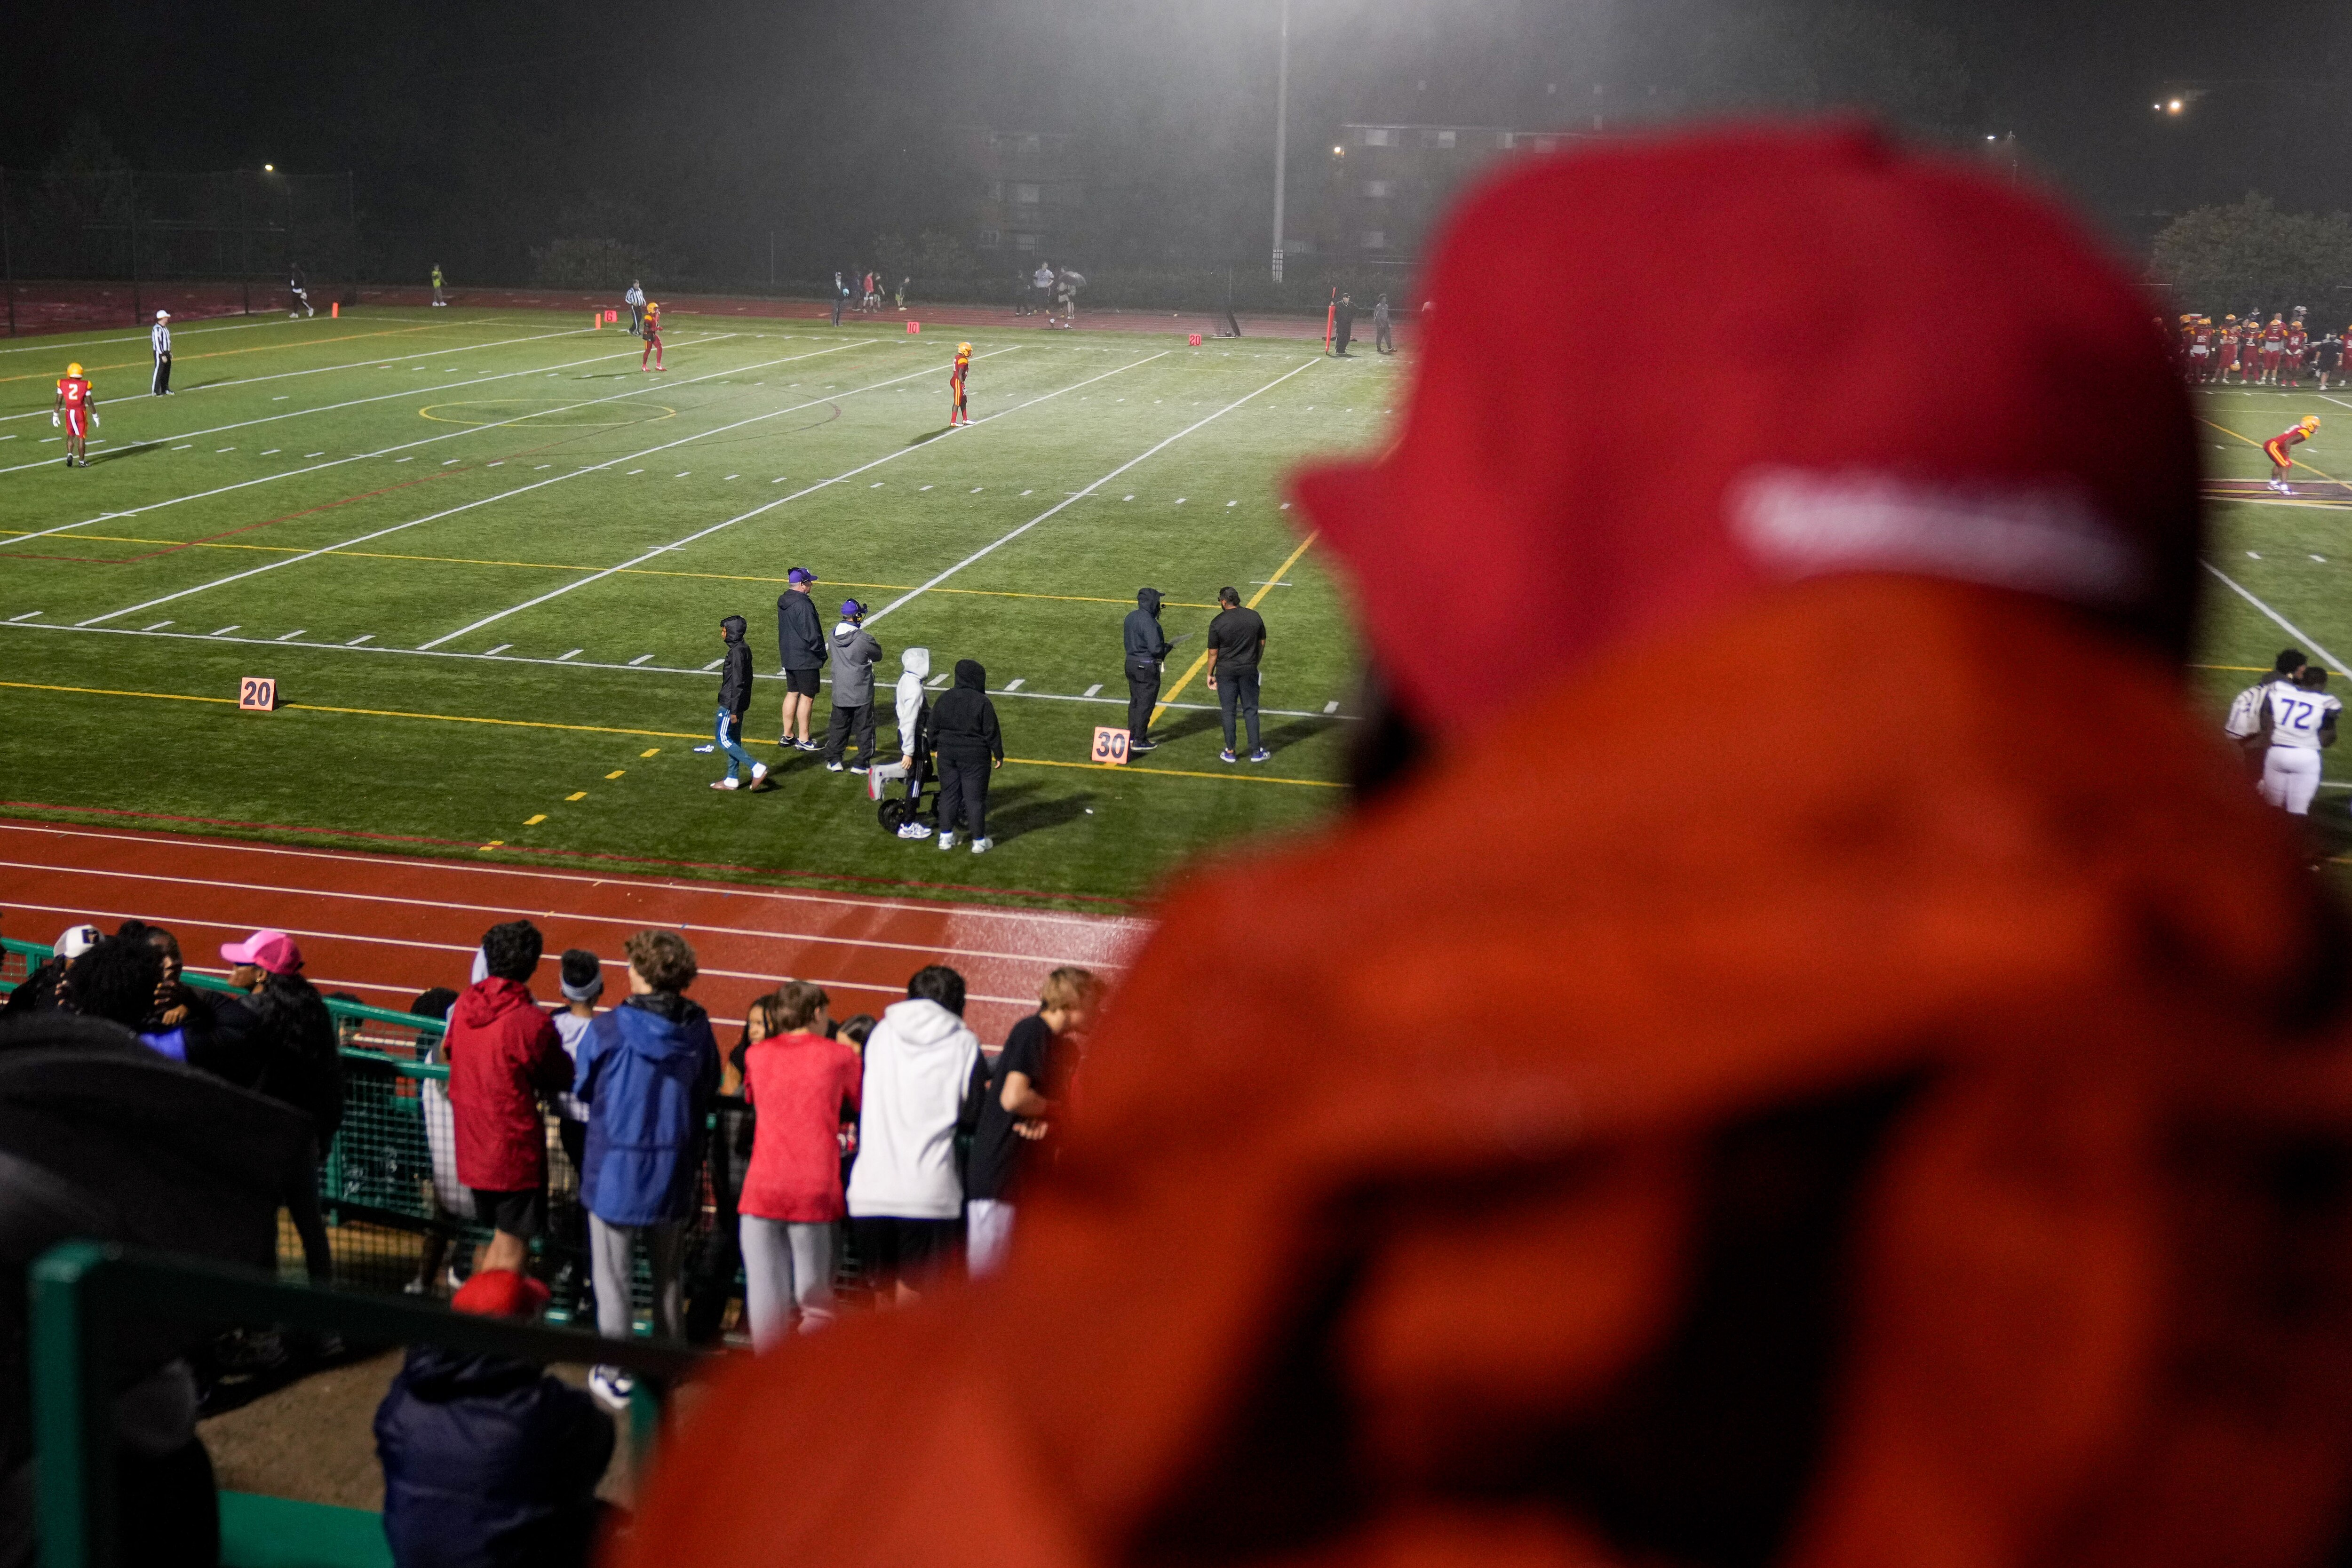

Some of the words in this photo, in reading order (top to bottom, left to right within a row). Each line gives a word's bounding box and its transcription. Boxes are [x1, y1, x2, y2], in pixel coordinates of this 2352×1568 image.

[607, 312, 612, 321] G
[909, 323, 917, 334] 10
[1190, 335, 1200, 345] 20
[68, 383, 78, 400] 2
[243, 681, 271, 707] 20
[2281, 698, 2313, 729] 72
[1096, 732, 1125, 758] 30
